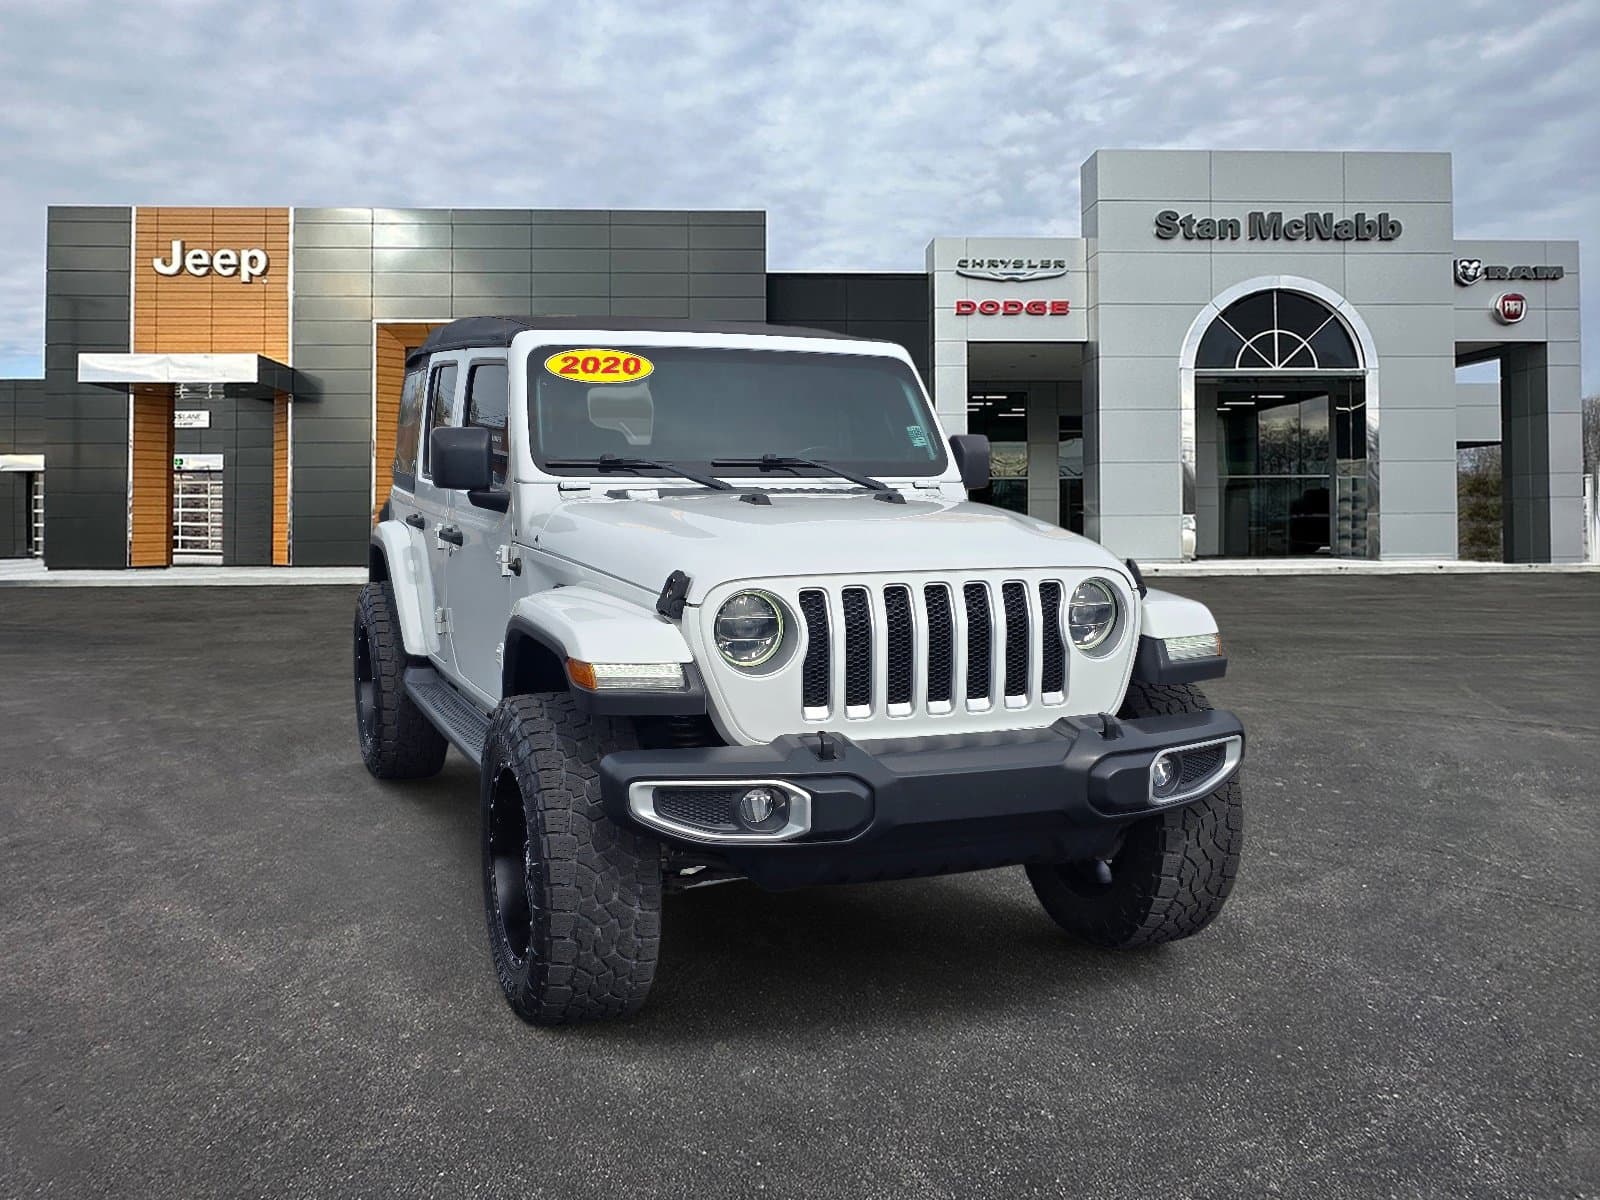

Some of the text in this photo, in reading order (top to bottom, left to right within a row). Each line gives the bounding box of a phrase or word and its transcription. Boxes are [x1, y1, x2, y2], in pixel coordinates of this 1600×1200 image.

[1155, 210, 1403, 241] Stan McNabb
[152, 239, 268, 284] Jeep
[957, 259, 1066, 269] CHRYSLER
[1484, 265, 1564, 281] RAM
[955, 300, 1070, 316] DODGE
[559, 355, 642, 375] 2020
